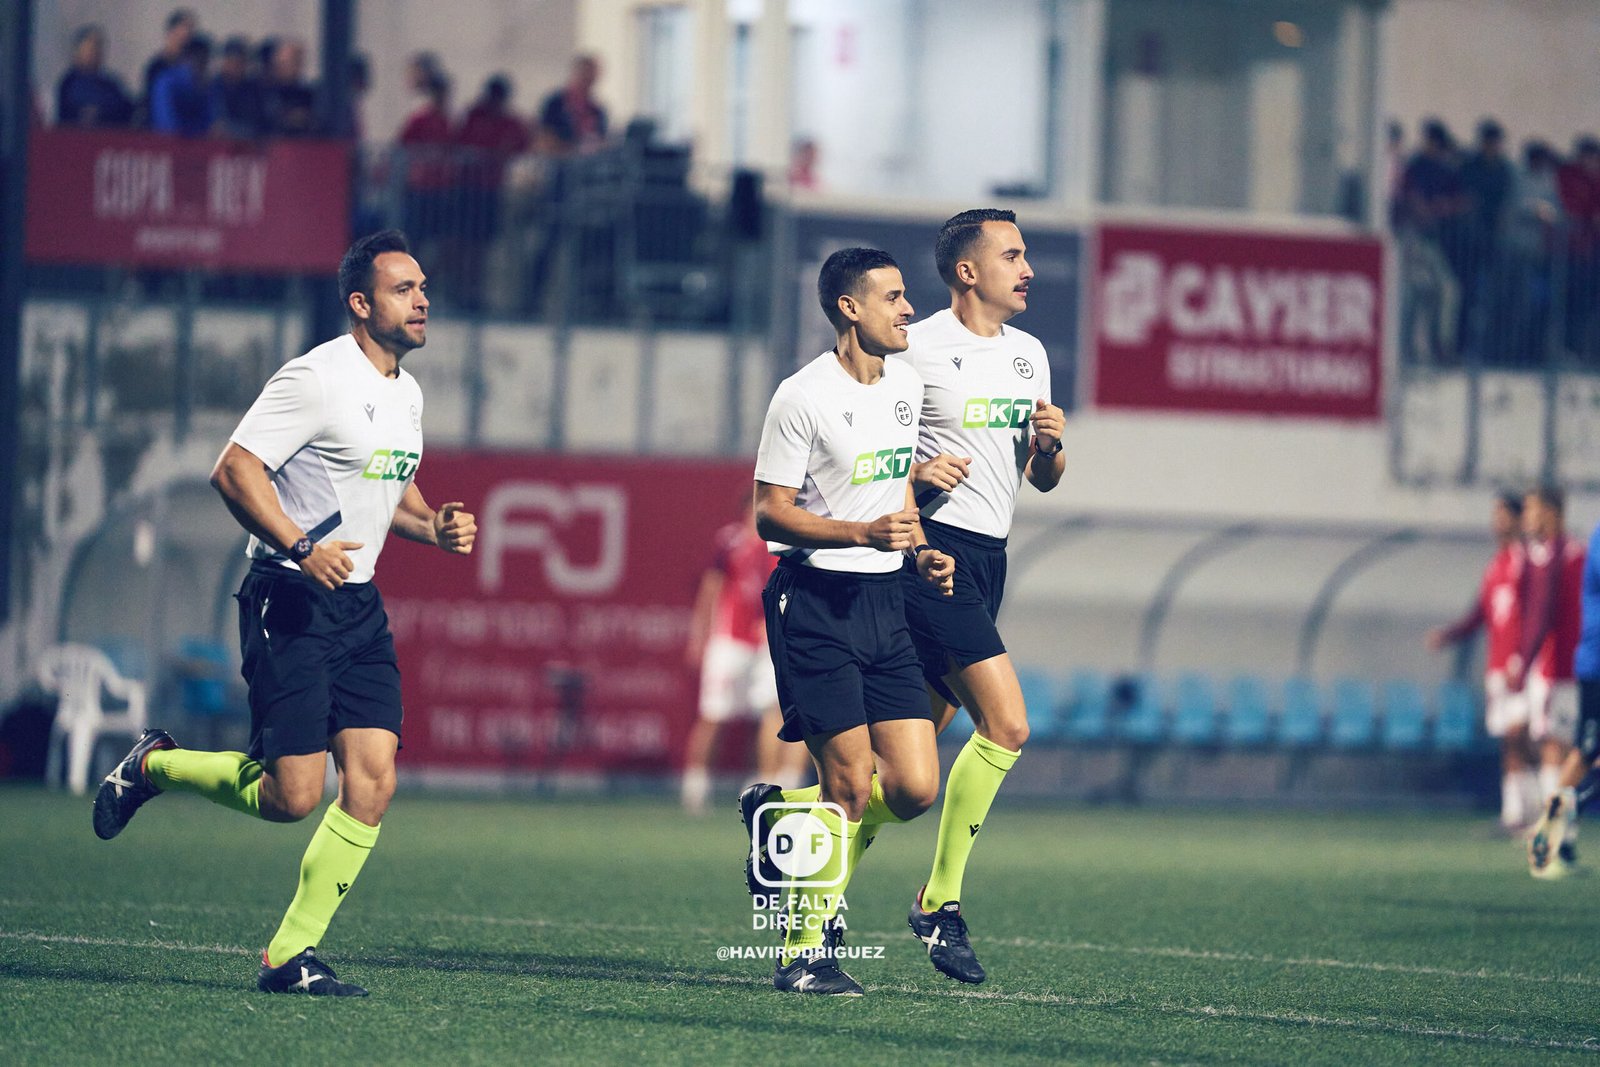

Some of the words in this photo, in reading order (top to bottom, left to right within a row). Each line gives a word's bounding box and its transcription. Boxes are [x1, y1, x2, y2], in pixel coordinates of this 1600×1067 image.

[964, 401, 1032, 425] BKT
[365, 452, 419, 479] BKT
[853, 450, 912, 481] BKT
